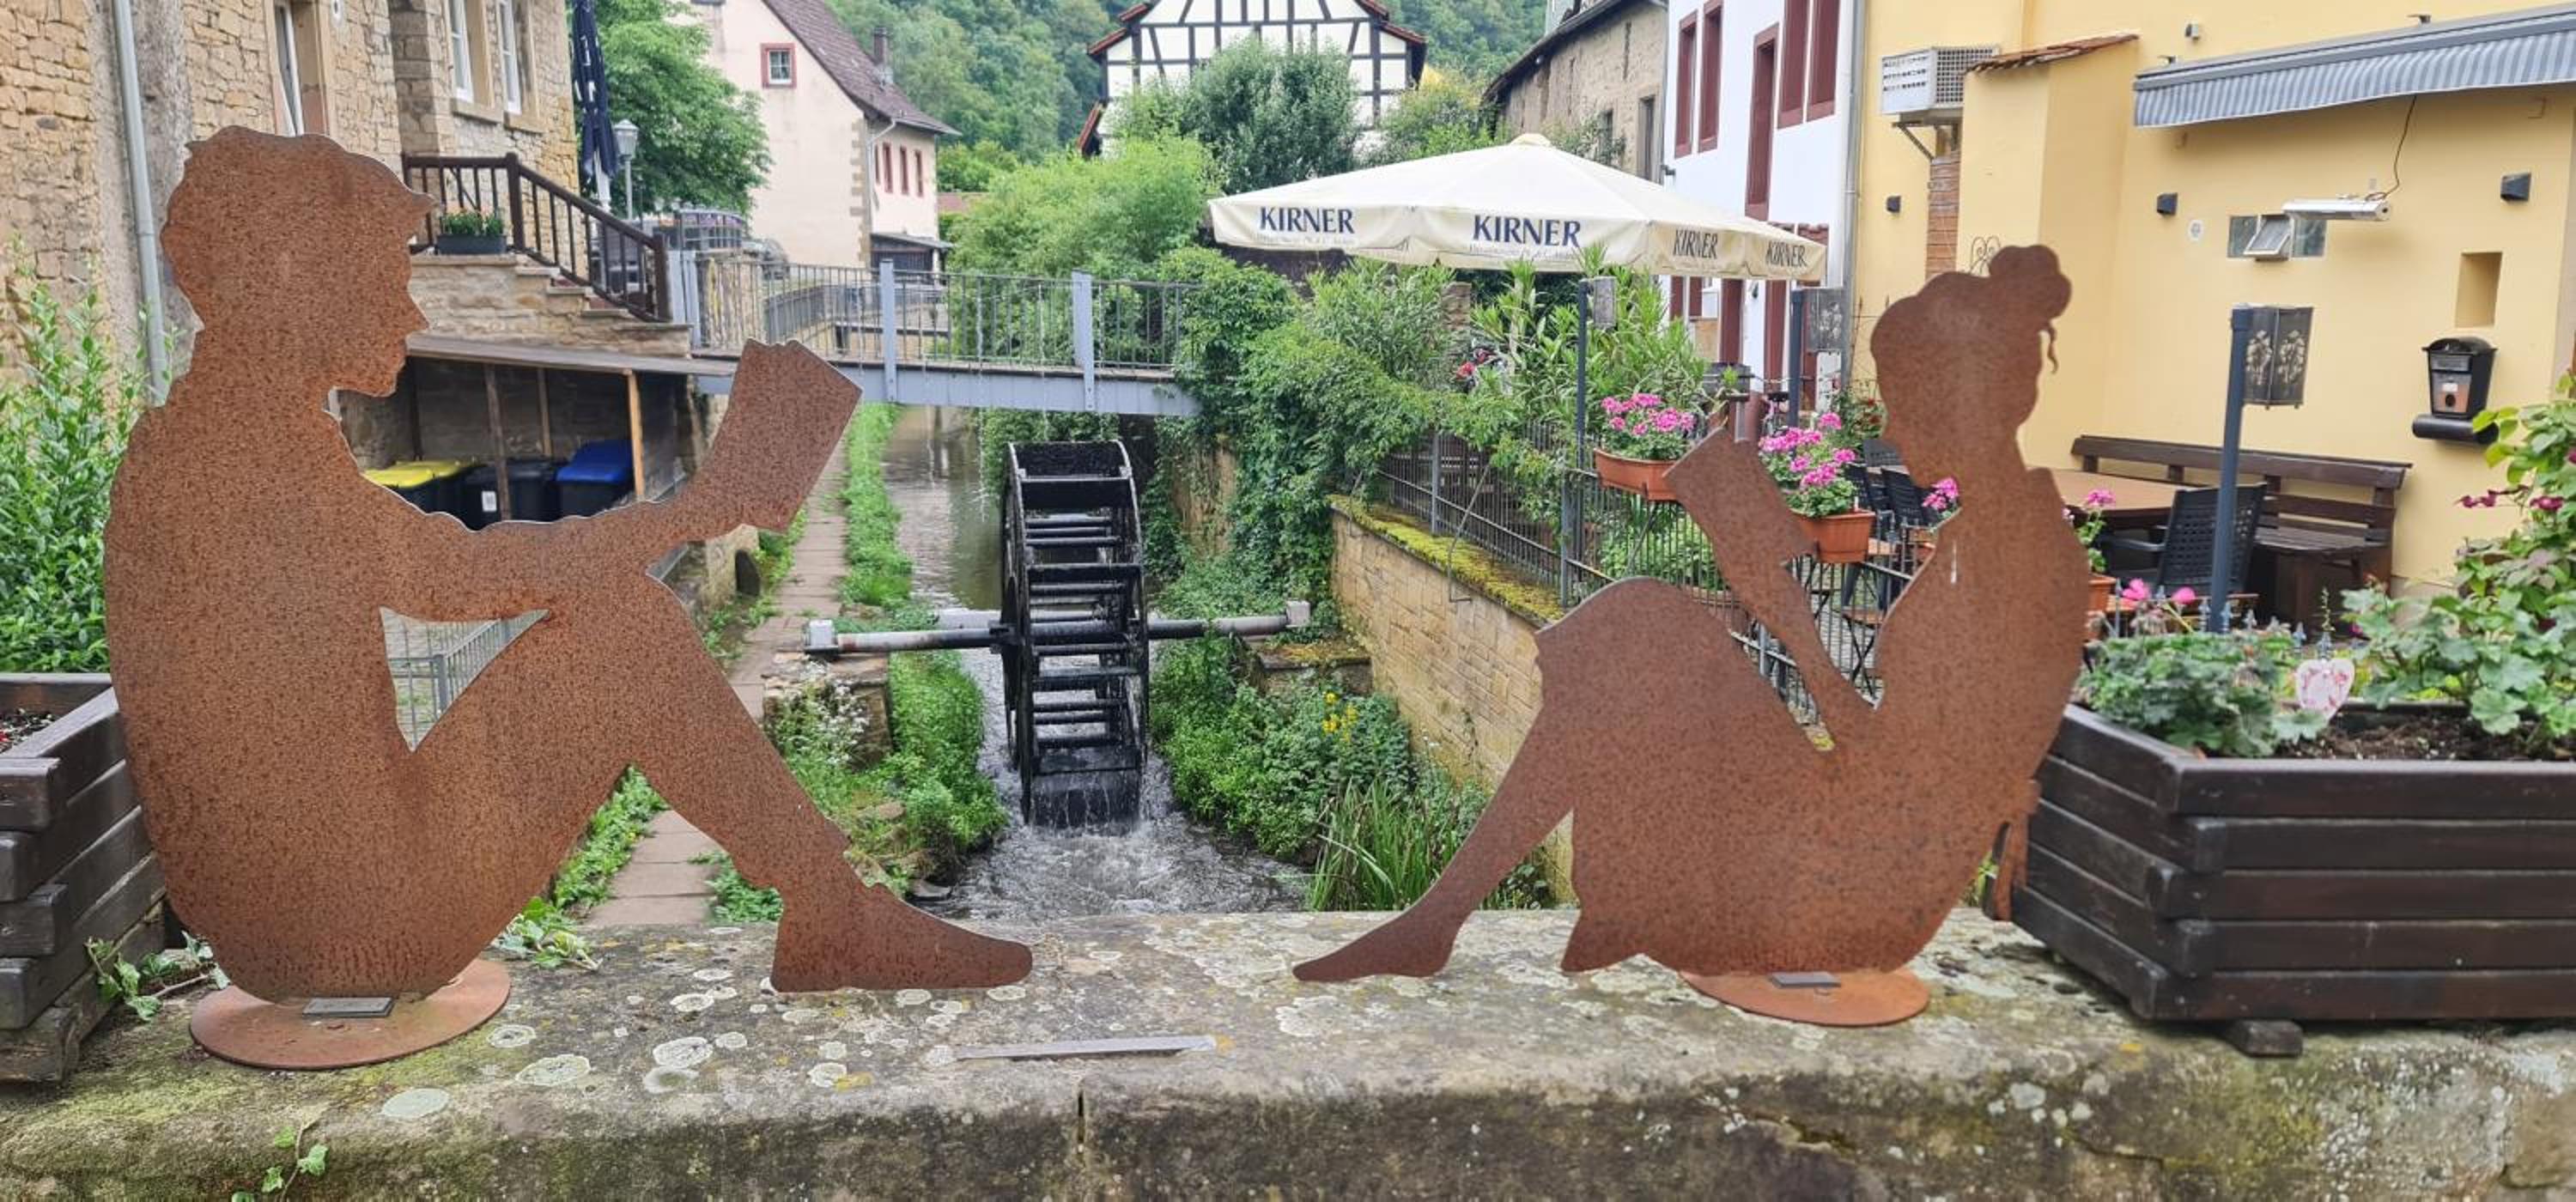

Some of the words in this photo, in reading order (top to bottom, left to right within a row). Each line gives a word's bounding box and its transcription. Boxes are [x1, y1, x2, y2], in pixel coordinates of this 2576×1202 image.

[1260, 206, 1355, 234] KIRNER
[1473, 215, 1581, 247] KIRNER
[1673, 229, 1718, 258] KIRNER
[1765, 240, 1808, 267] KIRNER
